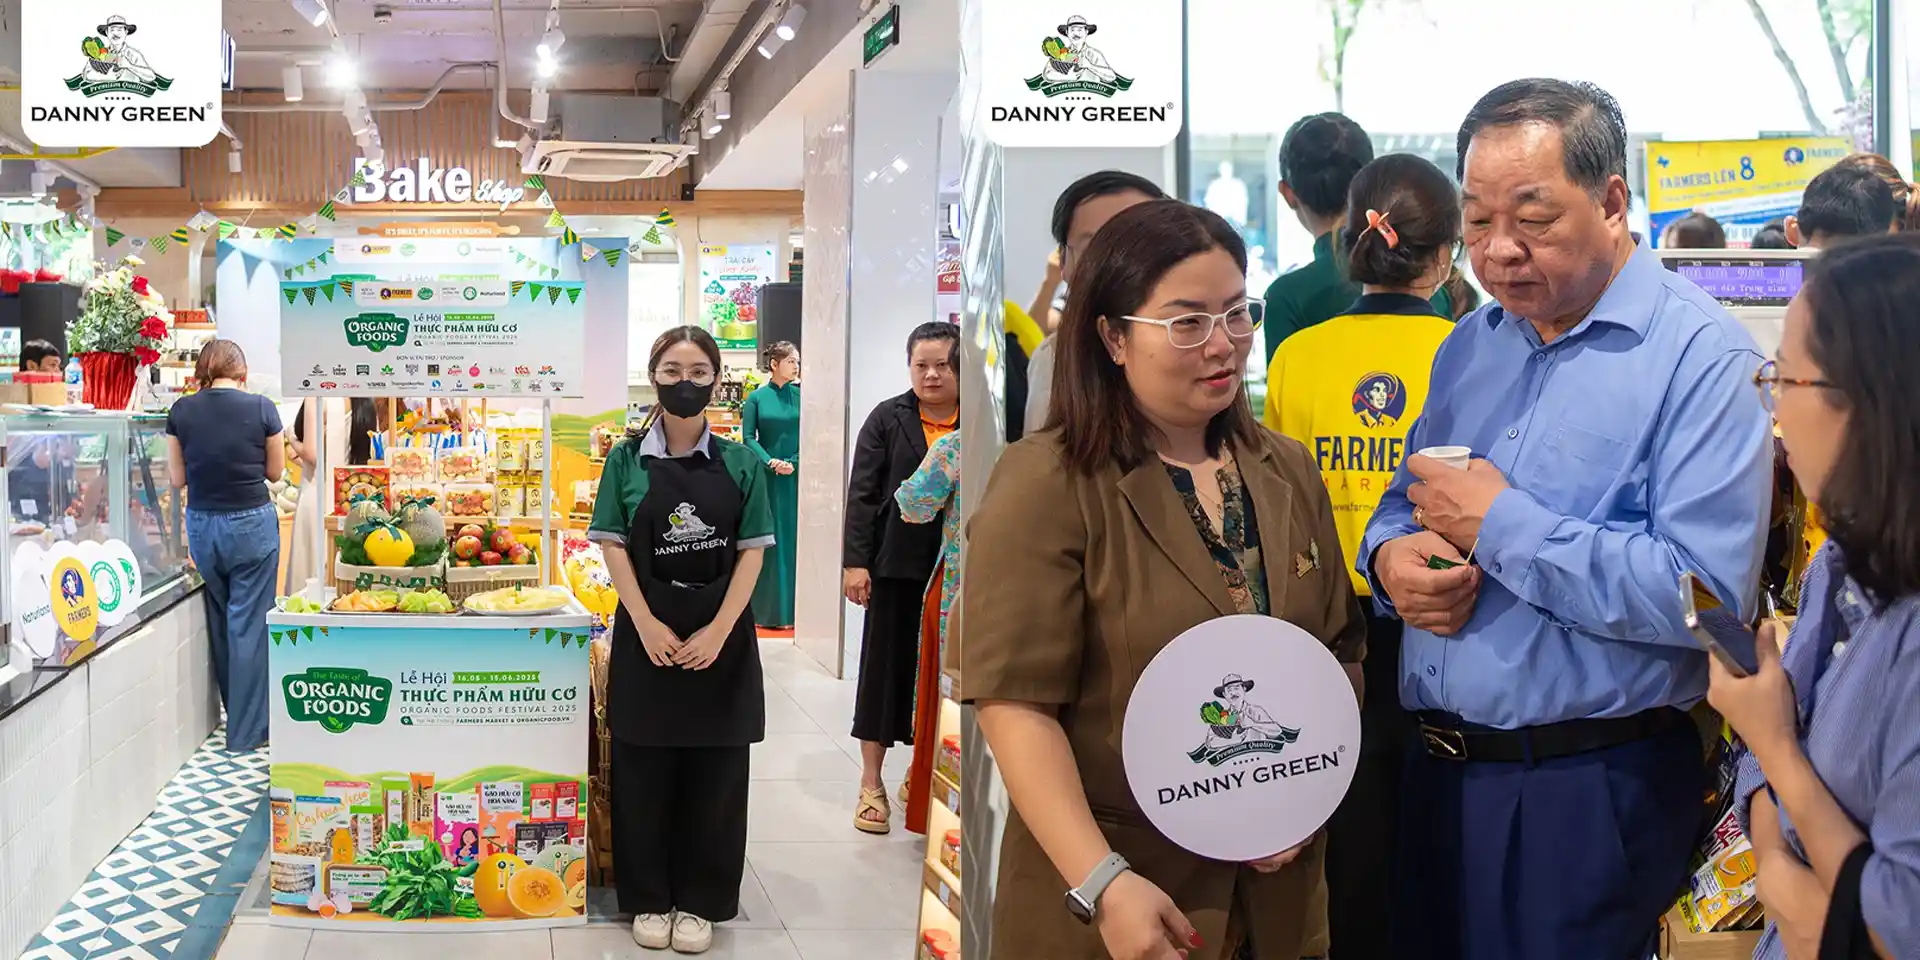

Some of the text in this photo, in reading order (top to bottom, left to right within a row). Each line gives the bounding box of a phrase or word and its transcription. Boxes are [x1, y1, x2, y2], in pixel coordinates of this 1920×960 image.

[1659, 172, 1712, 189] FARMERS
[1740, 156, 1755, 181] 8
[354, 157, 524, 212] Bake Shop
[348, 320, 405, 334] ORGANIC
[414, 324, 442, 334] THỰC
[501, 323, 518, 333] CƠ
[357, 332, 397, 342] FOODS
[1314, 435, 1404, 472] FARME
[1324, 477, 1391, 492] ARK
[67, 605, 92, 625] FARMERS
[400, 670, 448, 688] Lễ Hội
[489, 674, 537, 682] 15.06.2025
[288, 679, 385, 702] ORGANIC
[400, 685, 577, 706] THỰC PHẨM HỮU CƠ
[303, 699, 371, 717] FOODS
[400, 704, 577, 715] ORGANIC FOODS FESTIVAL 2025
[1216, 741, 1276, 762] Premium Quality
[1157, 751, 1340, 805] DANNY GREEN
